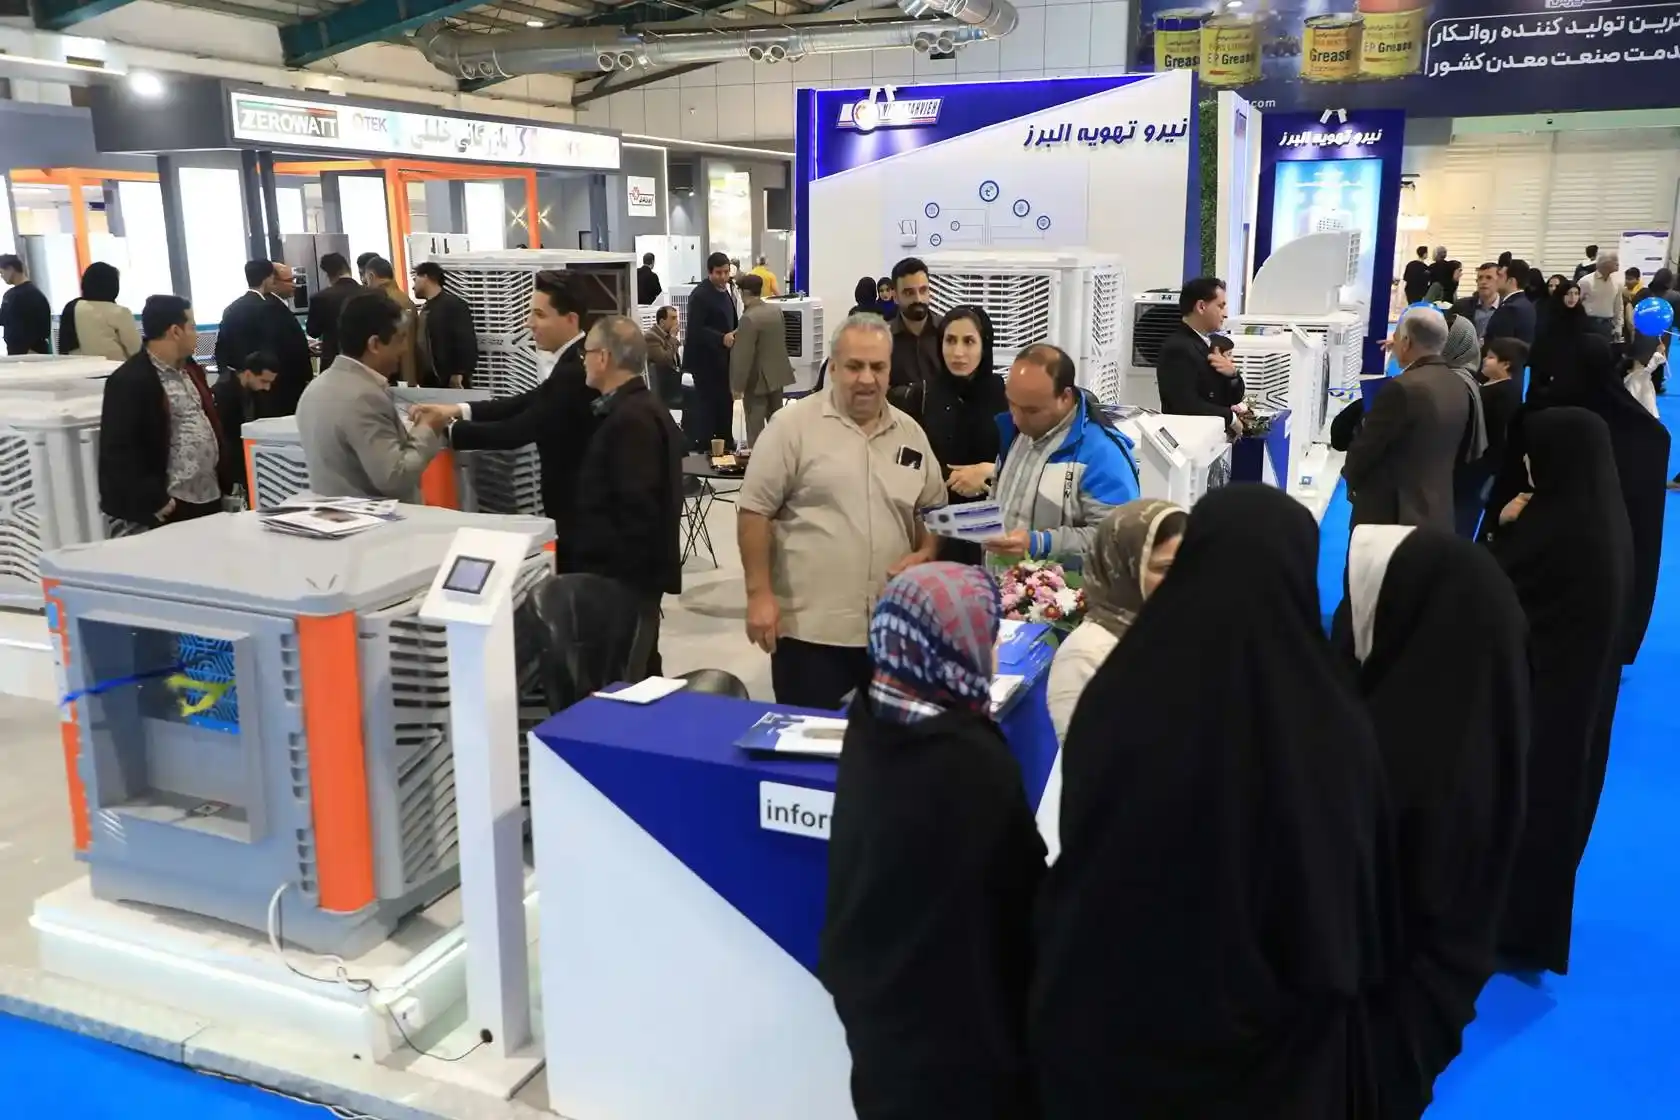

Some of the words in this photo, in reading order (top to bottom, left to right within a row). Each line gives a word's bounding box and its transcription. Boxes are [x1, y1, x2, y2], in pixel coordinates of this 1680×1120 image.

[1431, 23, 1497, 47] روانکار
[1501, 16, 1563, 38] کننده
[1565, 15, 1626, 38] تولید
[1165, 54, 1200, 68] Greas
[1428, 52, 1487, 77] کشور
[1486, 55, 1549, 73] معدن
[1551, 49, 1621, 66] صنعت
[1624, 45, 1680, 62] دمت
[240, 108, 337, 137] ZEROWATT
[1077, 120, 1138, 146] تهویه
[1144, 118, 1188, 143] نیرو
[1023, 123, 1072, 148] البرز
[1278, 130, 1313, 147] البرز
[1352, 128, 1383, 146] نیرو
[766, 799, 832, 829] infor
